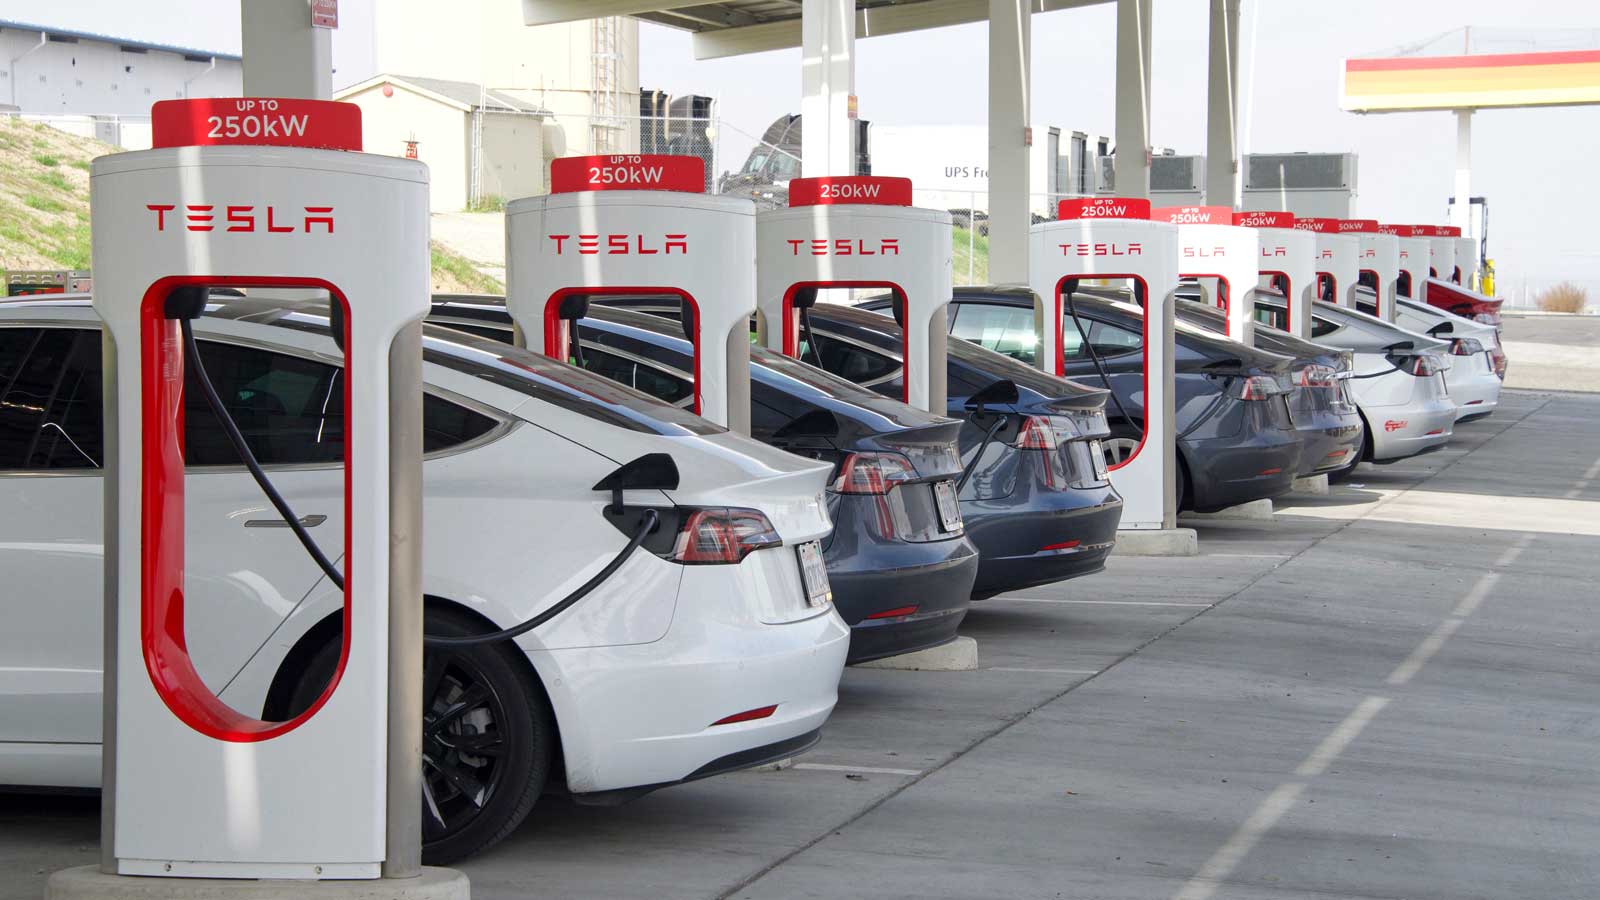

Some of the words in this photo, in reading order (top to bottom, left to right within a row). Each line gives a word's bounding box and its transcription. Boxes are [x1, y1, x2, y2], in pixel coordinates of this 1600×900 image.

[236, 101, 254, 111] UP
[259, 100, 278, 111] TO
[207, 115, 309, 138] 250kW
[610, 156, 624, 164] UP
[627, 155, 641, 164] TO
[589, 166, 663, 184] 250kW
[945, 166, 969, 178] UPS
[820, 184, 880, 198] 250kW
[1081, 206, 1126, 217] 250kW
[146, 204, 334, 233] TESLA
[1170, 213, 1210, 223] 250kW
[1240, 217, 1276, 227] 250kW
[549, 234, 687, 255] TESLA
[787, 239, 899, 255] TESLA
[1059, 243, 1142, 256] TESLA
[1184, 247, 1225, 257] SLA
